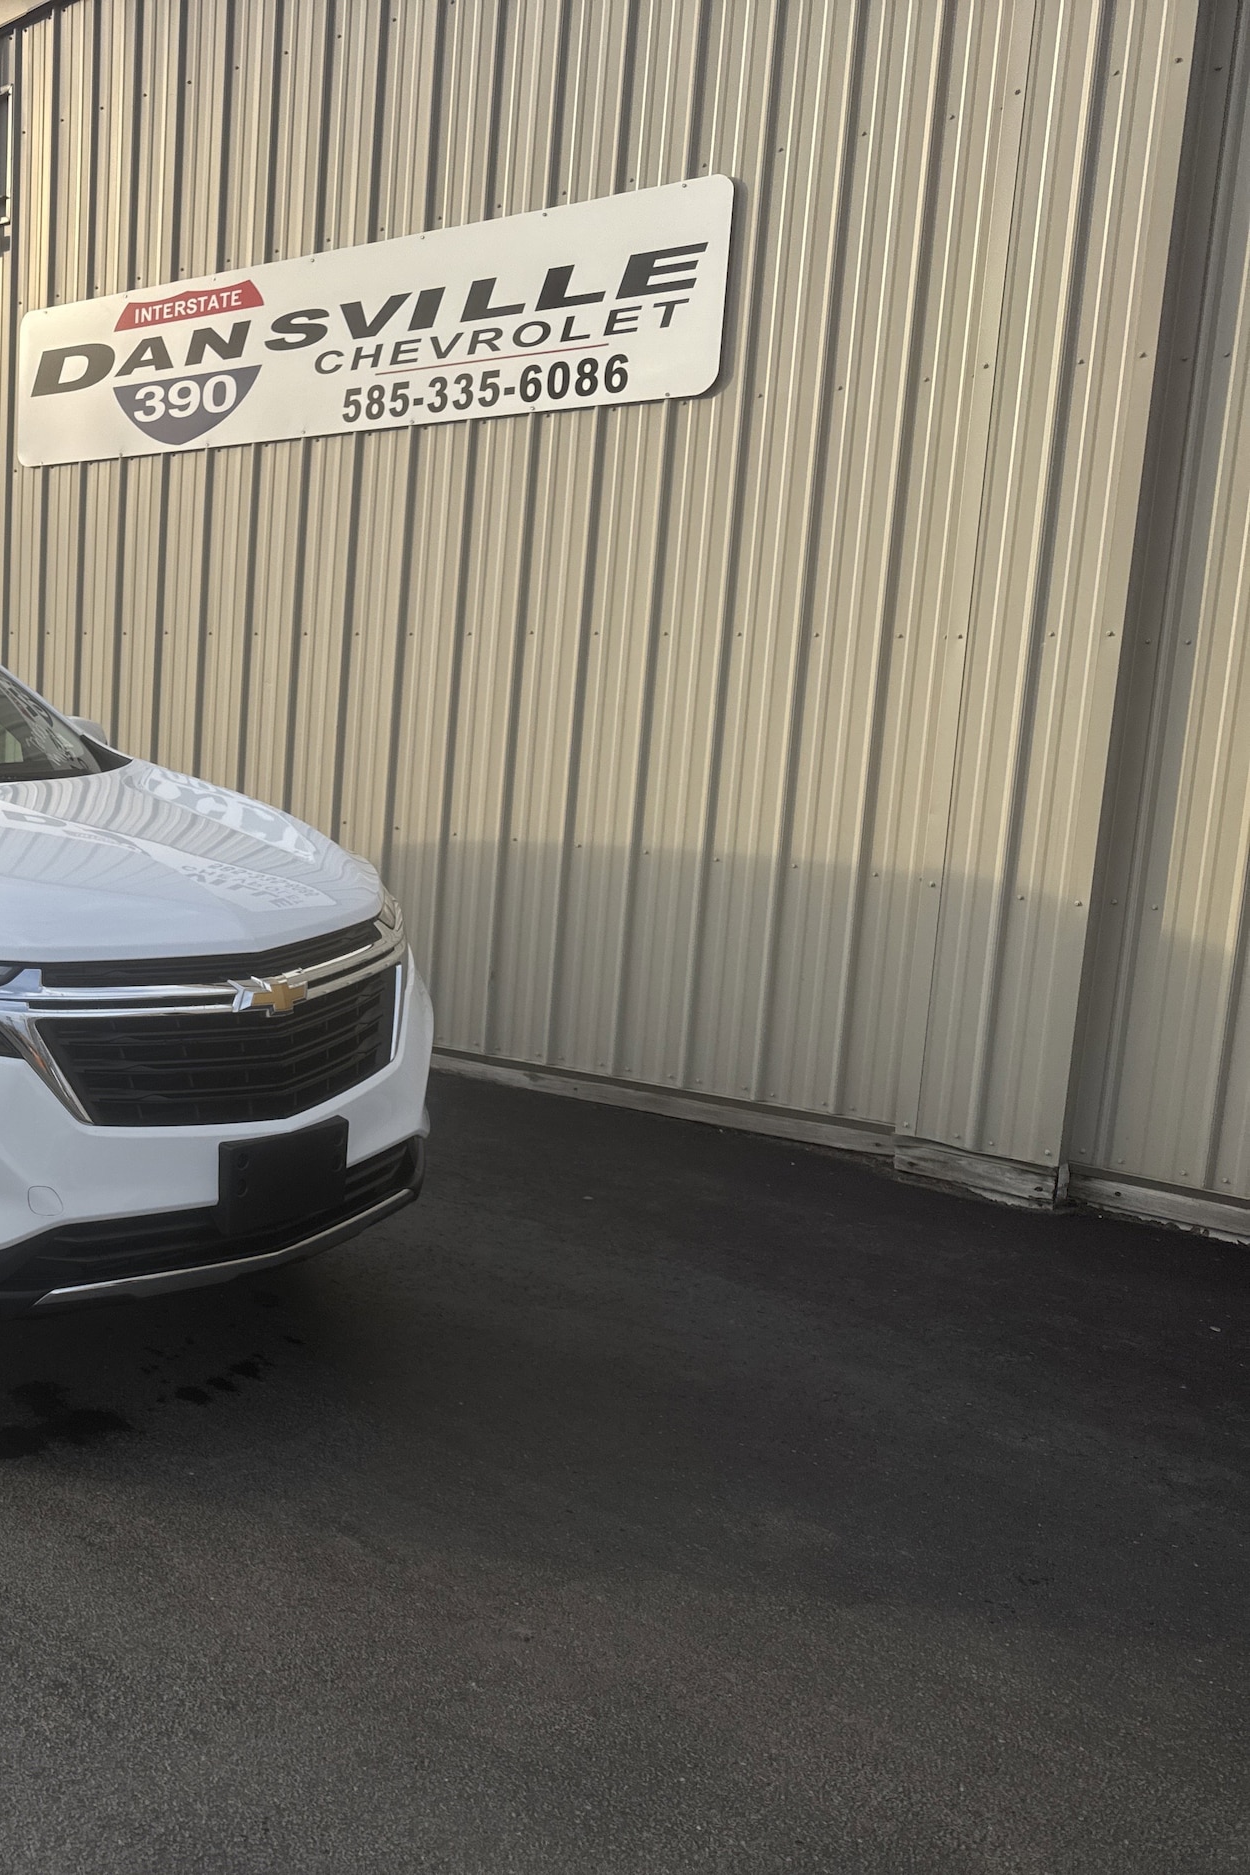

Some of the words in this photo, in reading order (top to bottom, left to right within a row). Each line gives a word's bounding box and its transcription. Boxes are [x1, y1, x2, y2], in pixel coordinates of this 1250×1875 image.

[134, 289, 242, 324] INTERSTATE
[314, 298, 689, 375] CHEVROLET
[134, 374, 237, 422] 390
[342, 354, 630, 423] 585-335-6086
